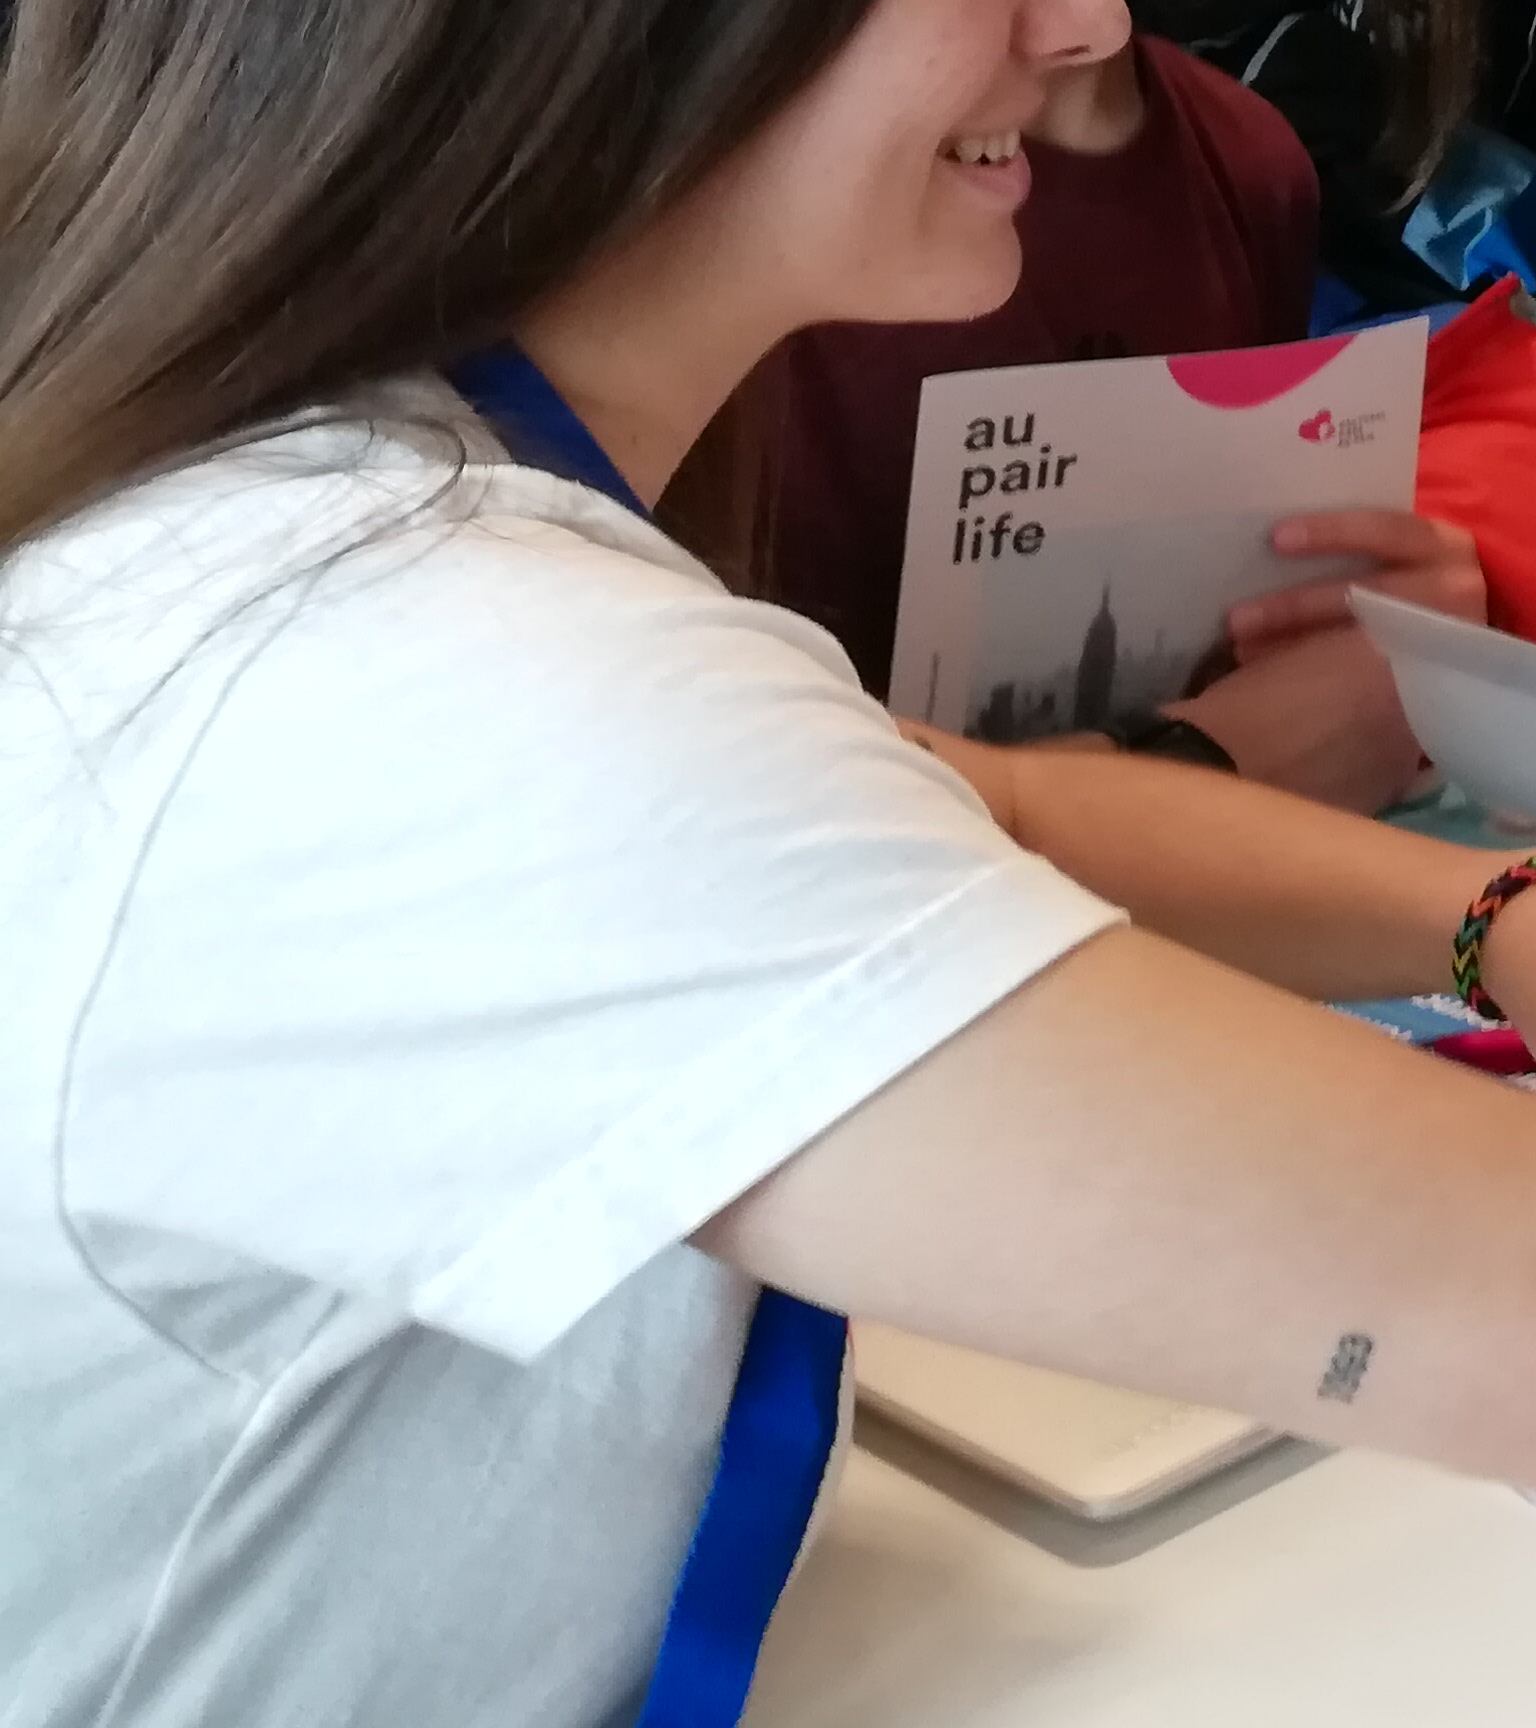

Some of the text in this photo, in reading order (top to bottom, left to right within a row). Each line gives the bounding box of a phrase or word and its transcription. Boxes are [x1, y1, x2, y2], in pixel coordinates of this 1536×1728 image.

[963, 411, 1036, 453] au
[957, 443, 1078, 511] pair
[952, 512, 1047, 566] life
